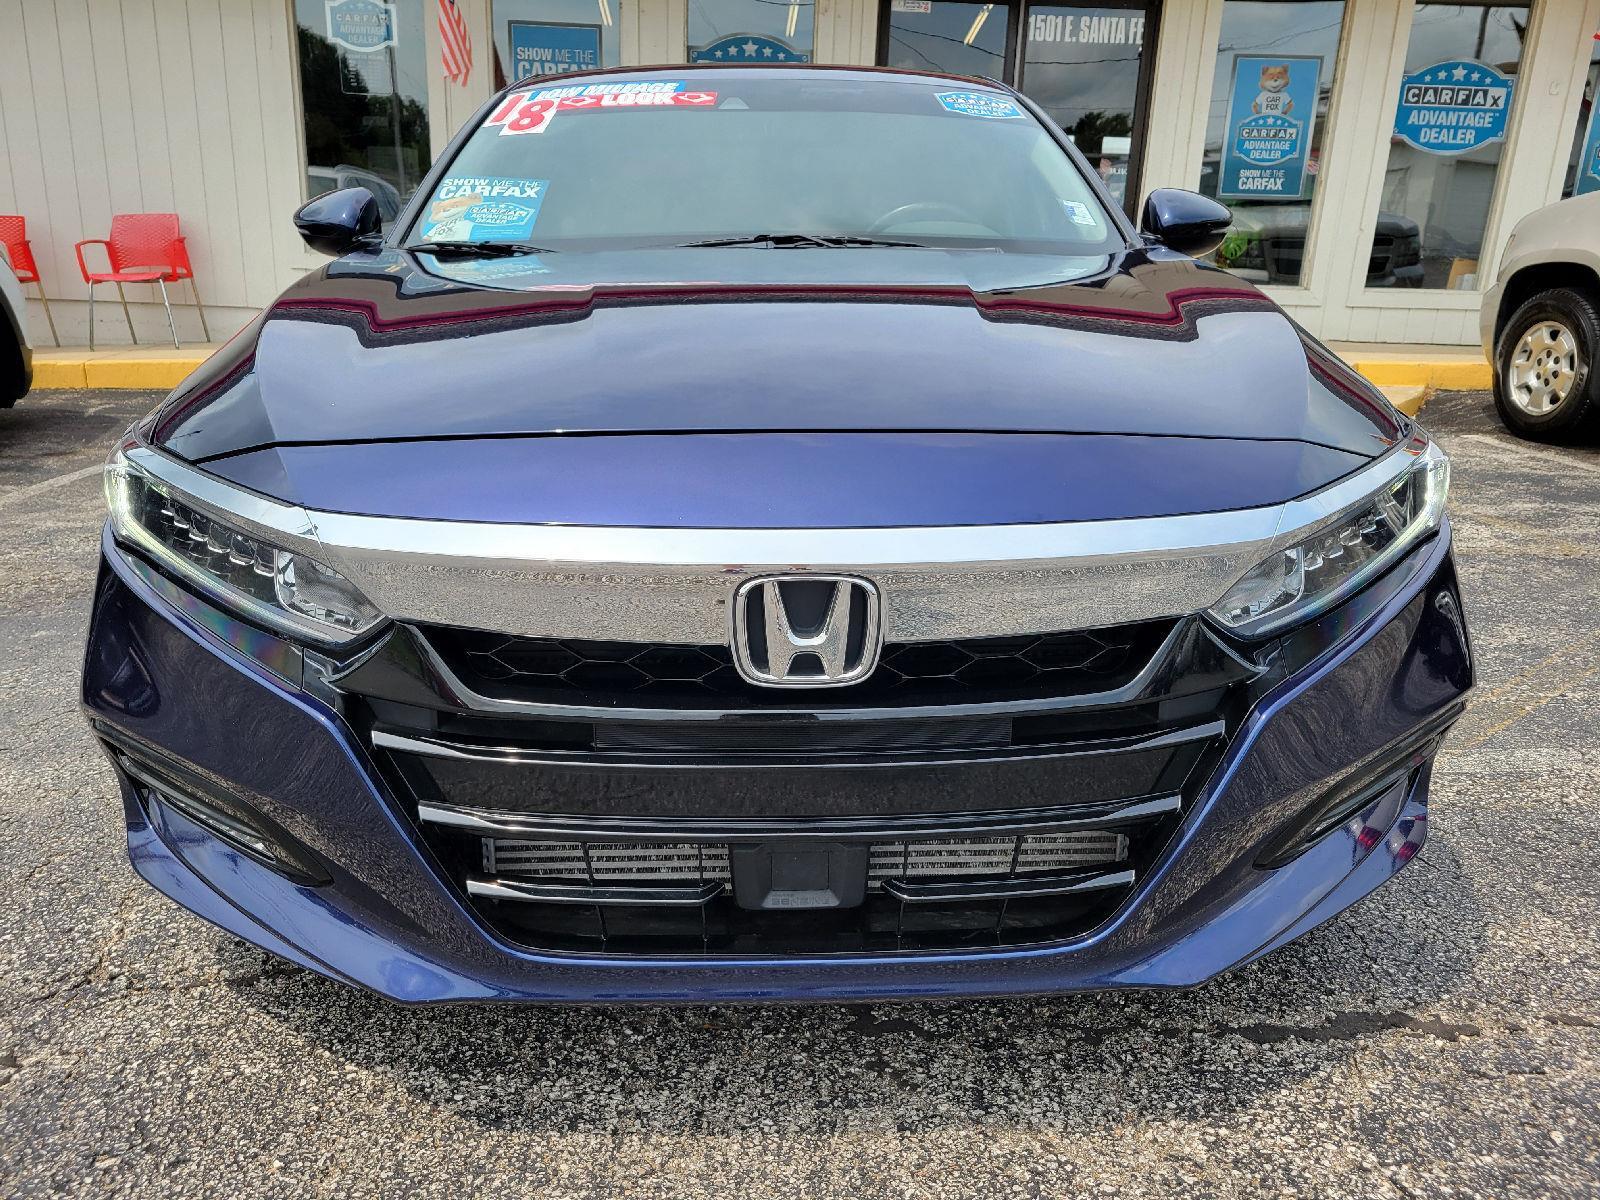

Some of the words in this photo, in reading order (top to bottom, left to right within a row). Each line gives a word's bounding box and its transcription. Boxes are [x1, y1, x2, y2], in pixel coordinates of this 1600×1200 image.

[1028, 14, 1063, 41] 1501
[1064, 15, 1076, 42] E.
[1080, 16, 1126, 44] SANTA
[1128, 17, 1145, 45] FE
[517, 47, 552, 60] SHOW
[555, 49, 572, 62] ME
[573, 50, 594, 63] THE
[517, 61, 596, 80] CARF
[601, 92, 675, 105] LOOK
[1407, 88, 1502, 108] CARFAX
[1242, 128, 1295, 139] CARFAX
[1420, 128, 1475, 144] DEALER
[1243, 140, 1290, 150] ADVANTAGE
[1249, 150, 1281, 159] DEALER
[1239, 169, 1261, 178] SHOW
[1261, 170, 1272, 178] ME
[1273, 170, 1285, 178] THE
[443, 179, 489, 187] SHOW
[492, 179, 513, 187] ME
[1238, 177, 1285, 190] CARFAX
[439, 185, 540, 199] CARFAX
